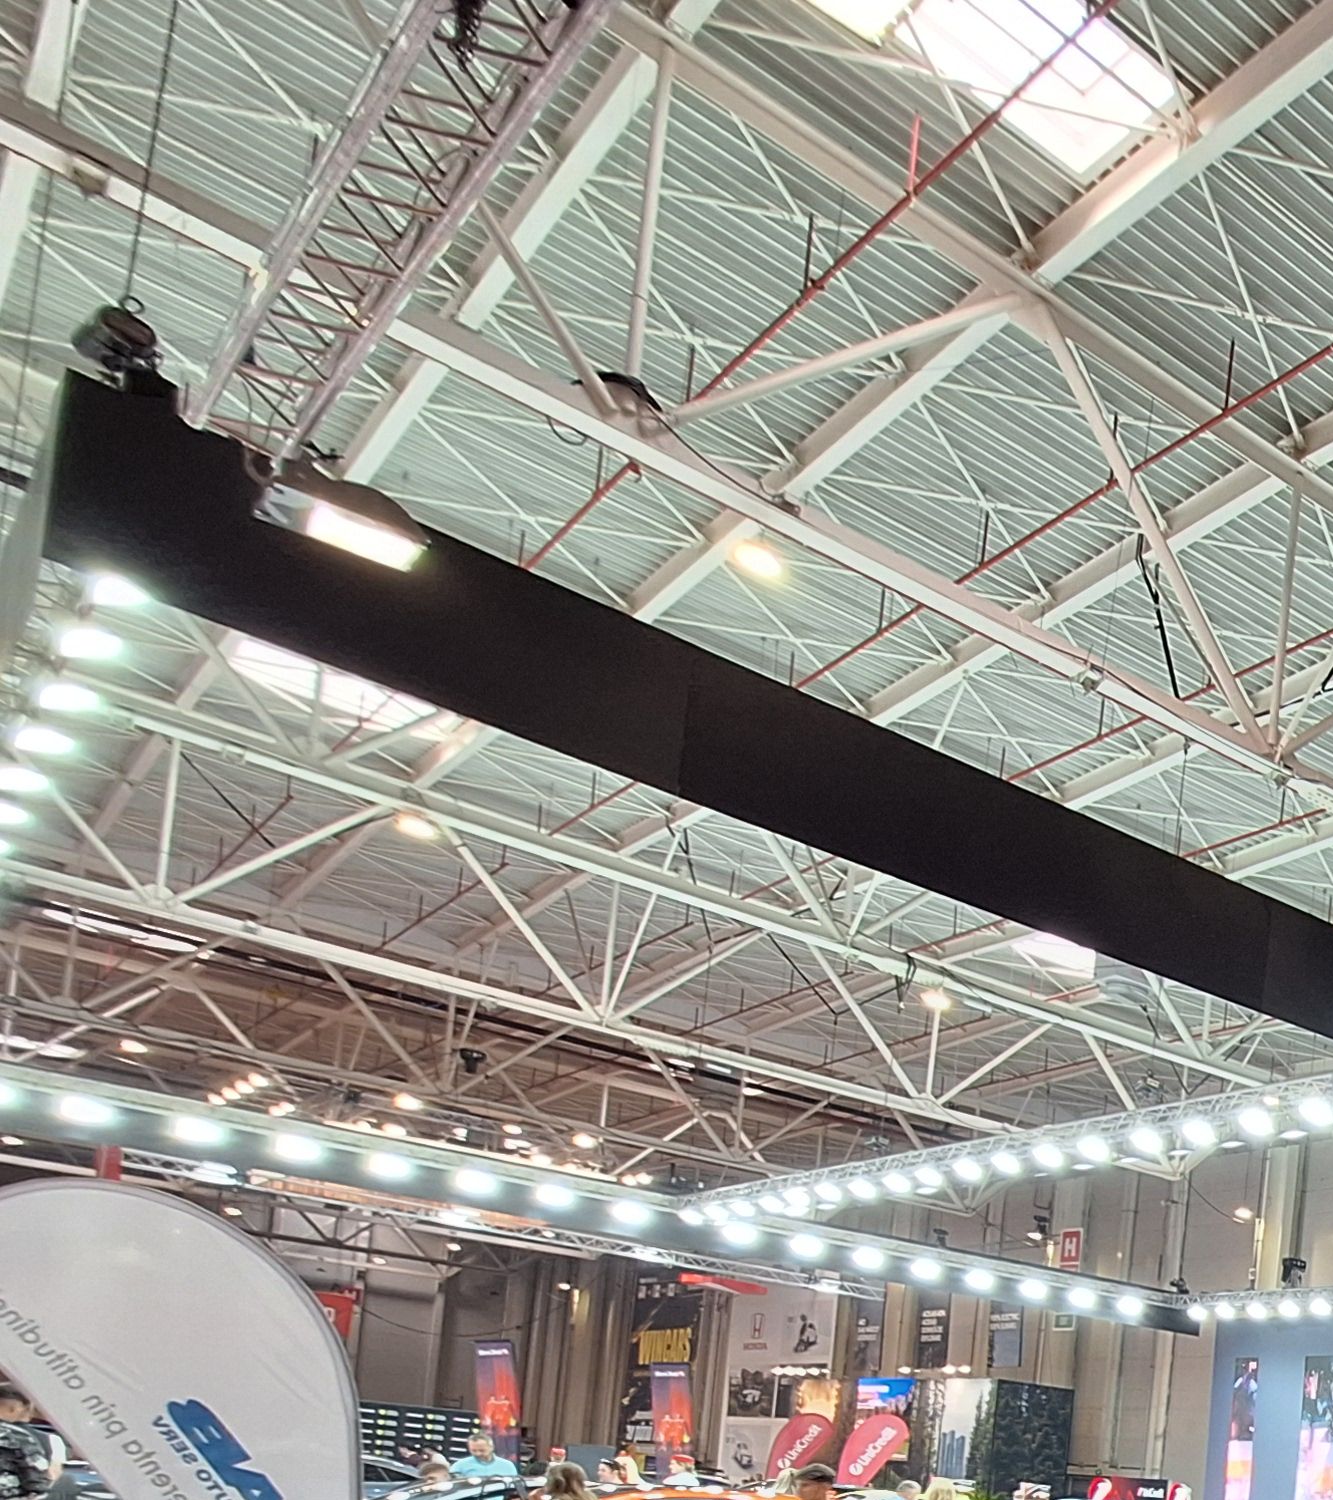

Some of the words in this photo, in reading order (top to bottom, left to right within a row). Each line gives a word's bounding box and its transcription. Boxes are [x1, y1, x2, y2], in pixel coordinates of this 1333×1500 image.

[1064, 1235, 1077, 1258] H
[785, 1424, 822, 1461] UniCredit
[860, 1427, 897, 1467] UniCredit
